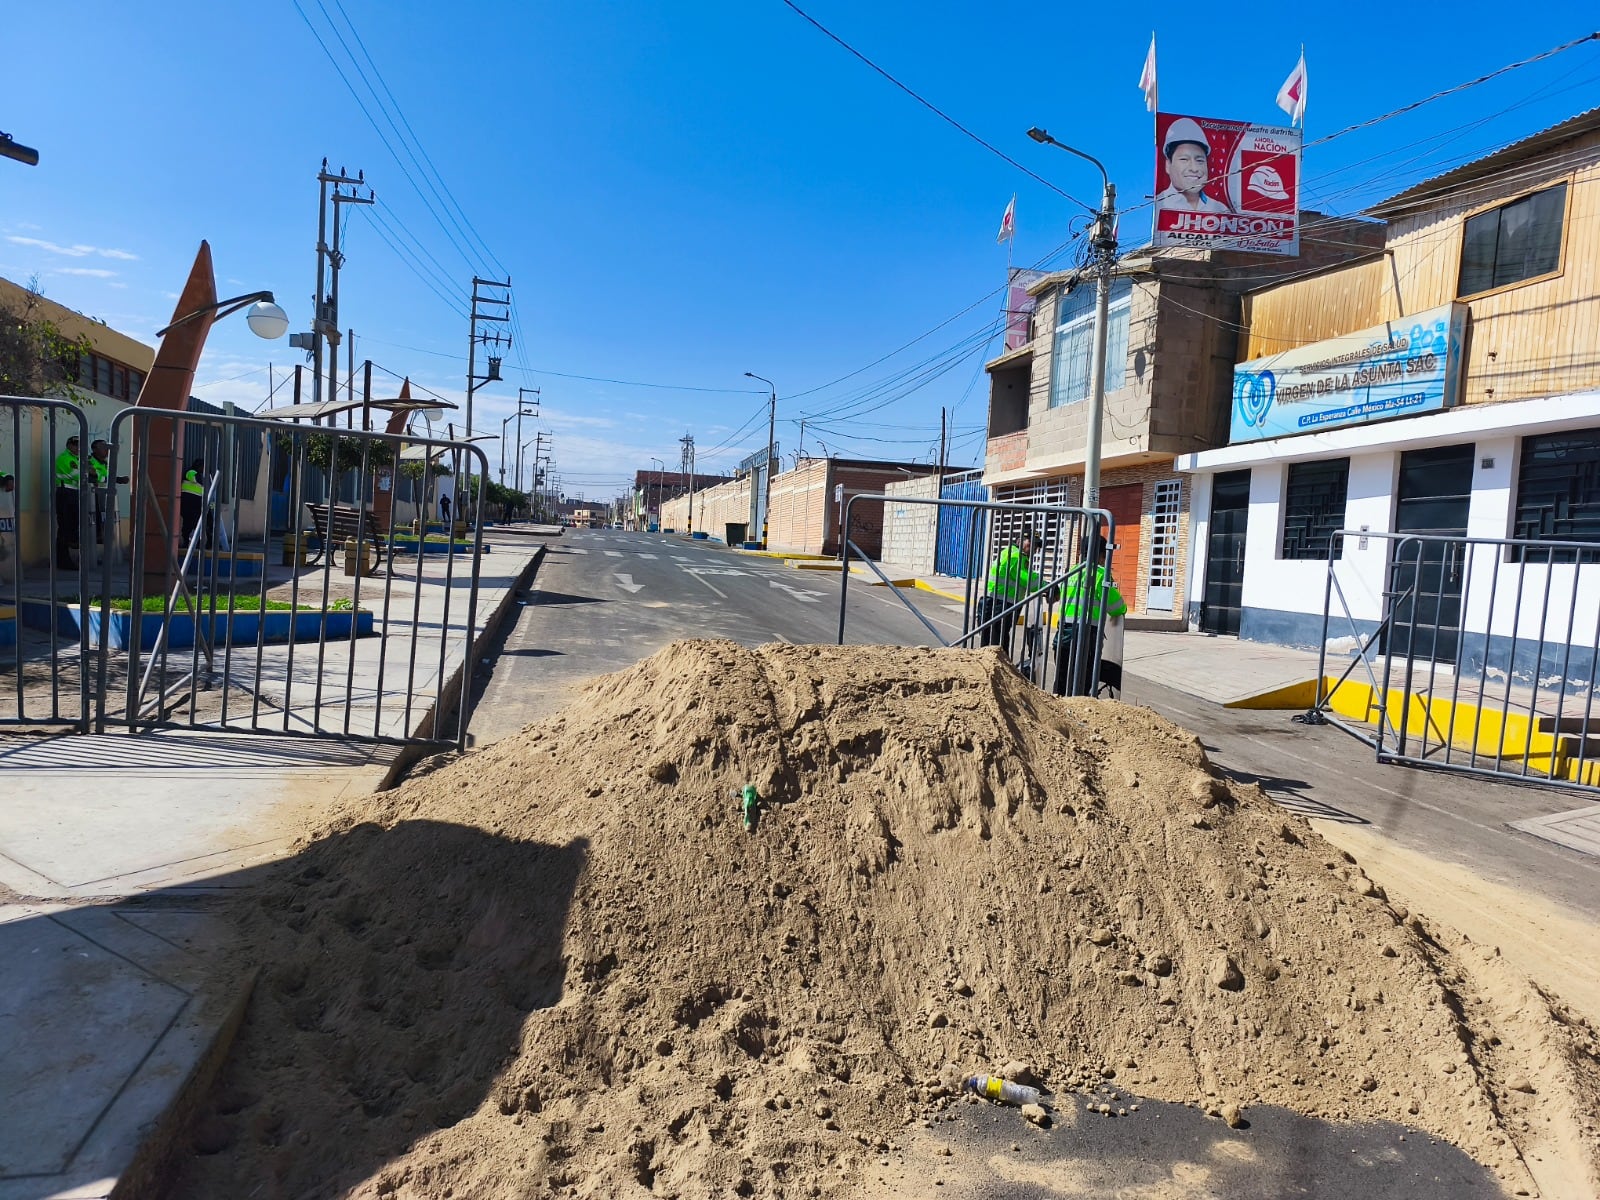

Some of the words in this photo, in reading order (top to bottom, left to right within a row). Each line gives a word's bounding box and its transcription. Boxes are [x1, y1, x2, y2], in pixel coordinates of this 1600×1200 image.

[1169, 213, 1285, 237] JHONSON
[1299, 358, 1331, 373] SERVICIOS
[1331, 348, 1370, 365] INTEGRALES
[1372, 344, 1382, 355] DE
[1383, 338, 1407, 351] SALUD
[1275, 381, 1313, 402] VIRGEN
[1316, 377, 1333, 394] DE
[1335, 373, 1349, 389] LA
[1352, 360, 1403, 387] ASUNTA
[1406, 353, 1436, 374] SAC
[1319, 411, 1346, 422] Esperanza
[1347, 407, 1361, 416] Calle
